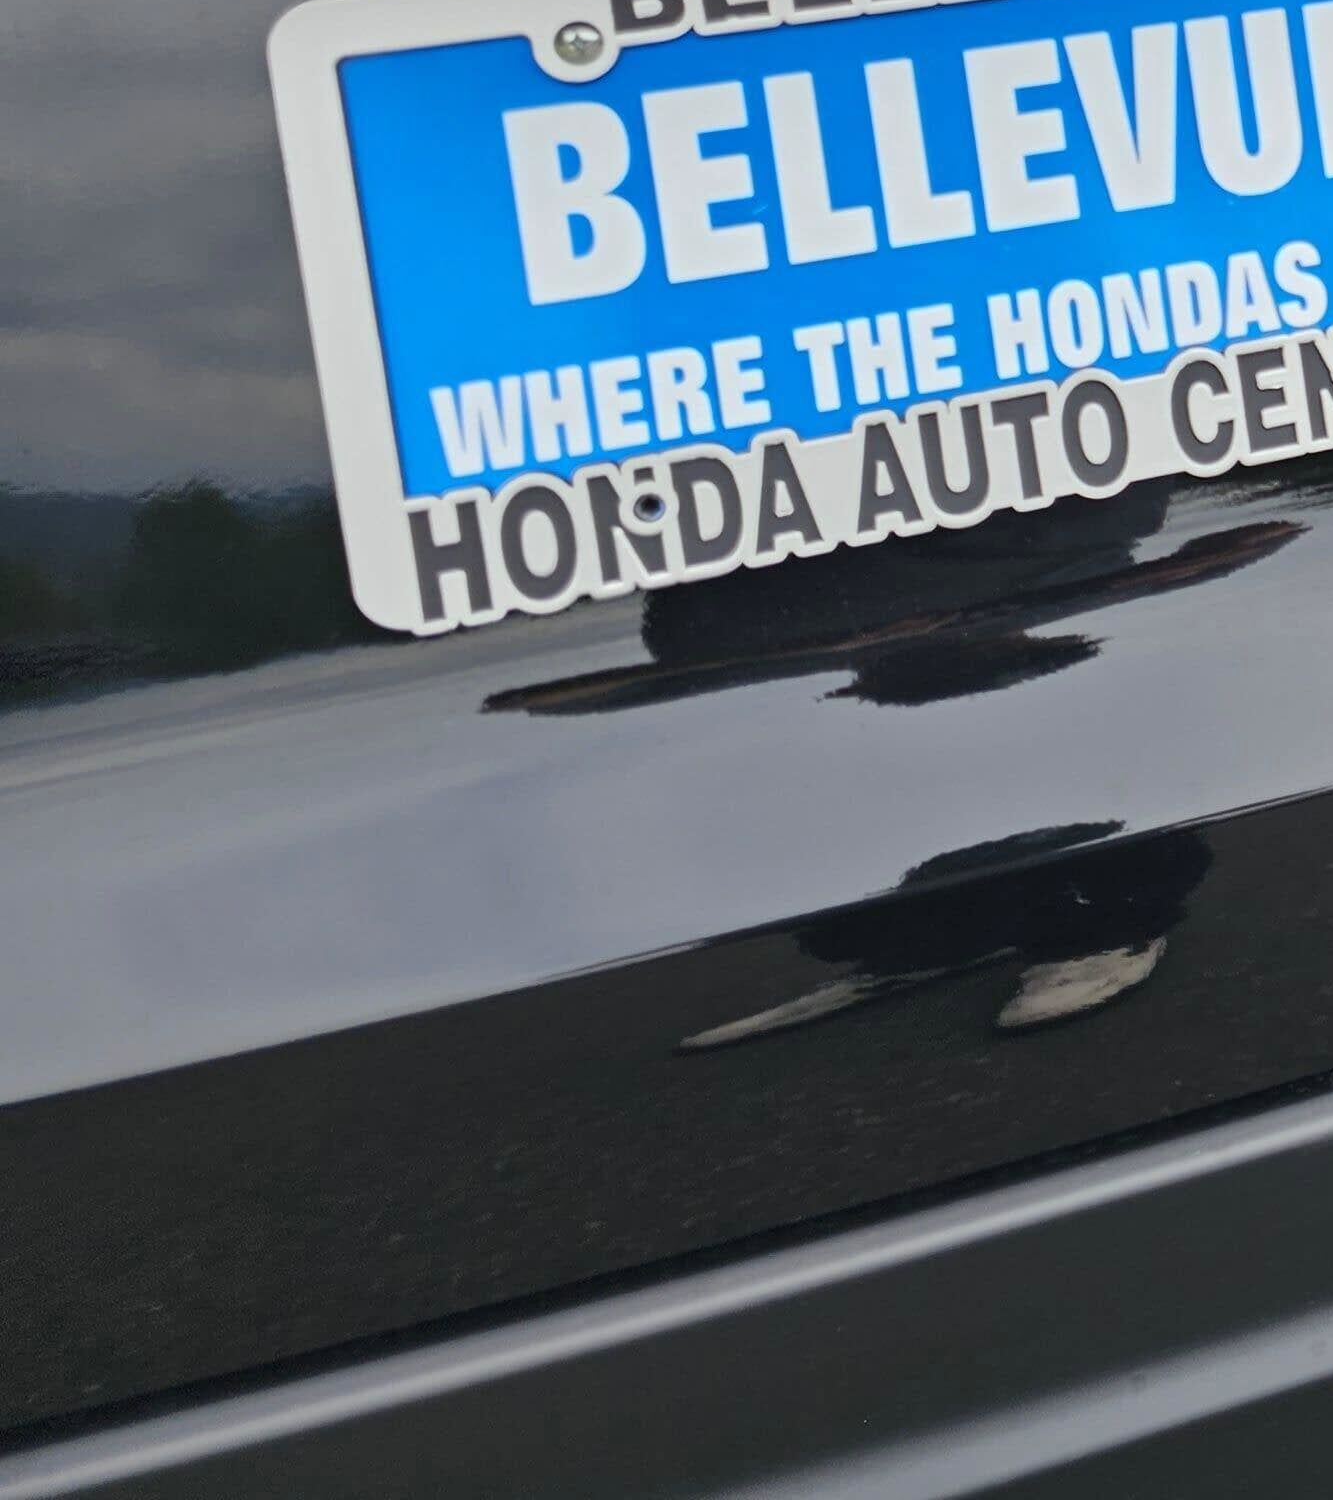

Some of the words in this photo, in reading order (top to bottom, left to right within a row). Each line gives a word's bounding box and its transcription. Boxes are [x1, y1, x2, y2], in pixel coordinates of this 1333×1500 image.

[429, 335, 772, 479] WHERE
[792, 302, 963, 413] THE
[987, 240, 1329, 380] HONDAS
[407, 441, 824, 622] HONDA
[856, 378, 1128, 534] AUTO
